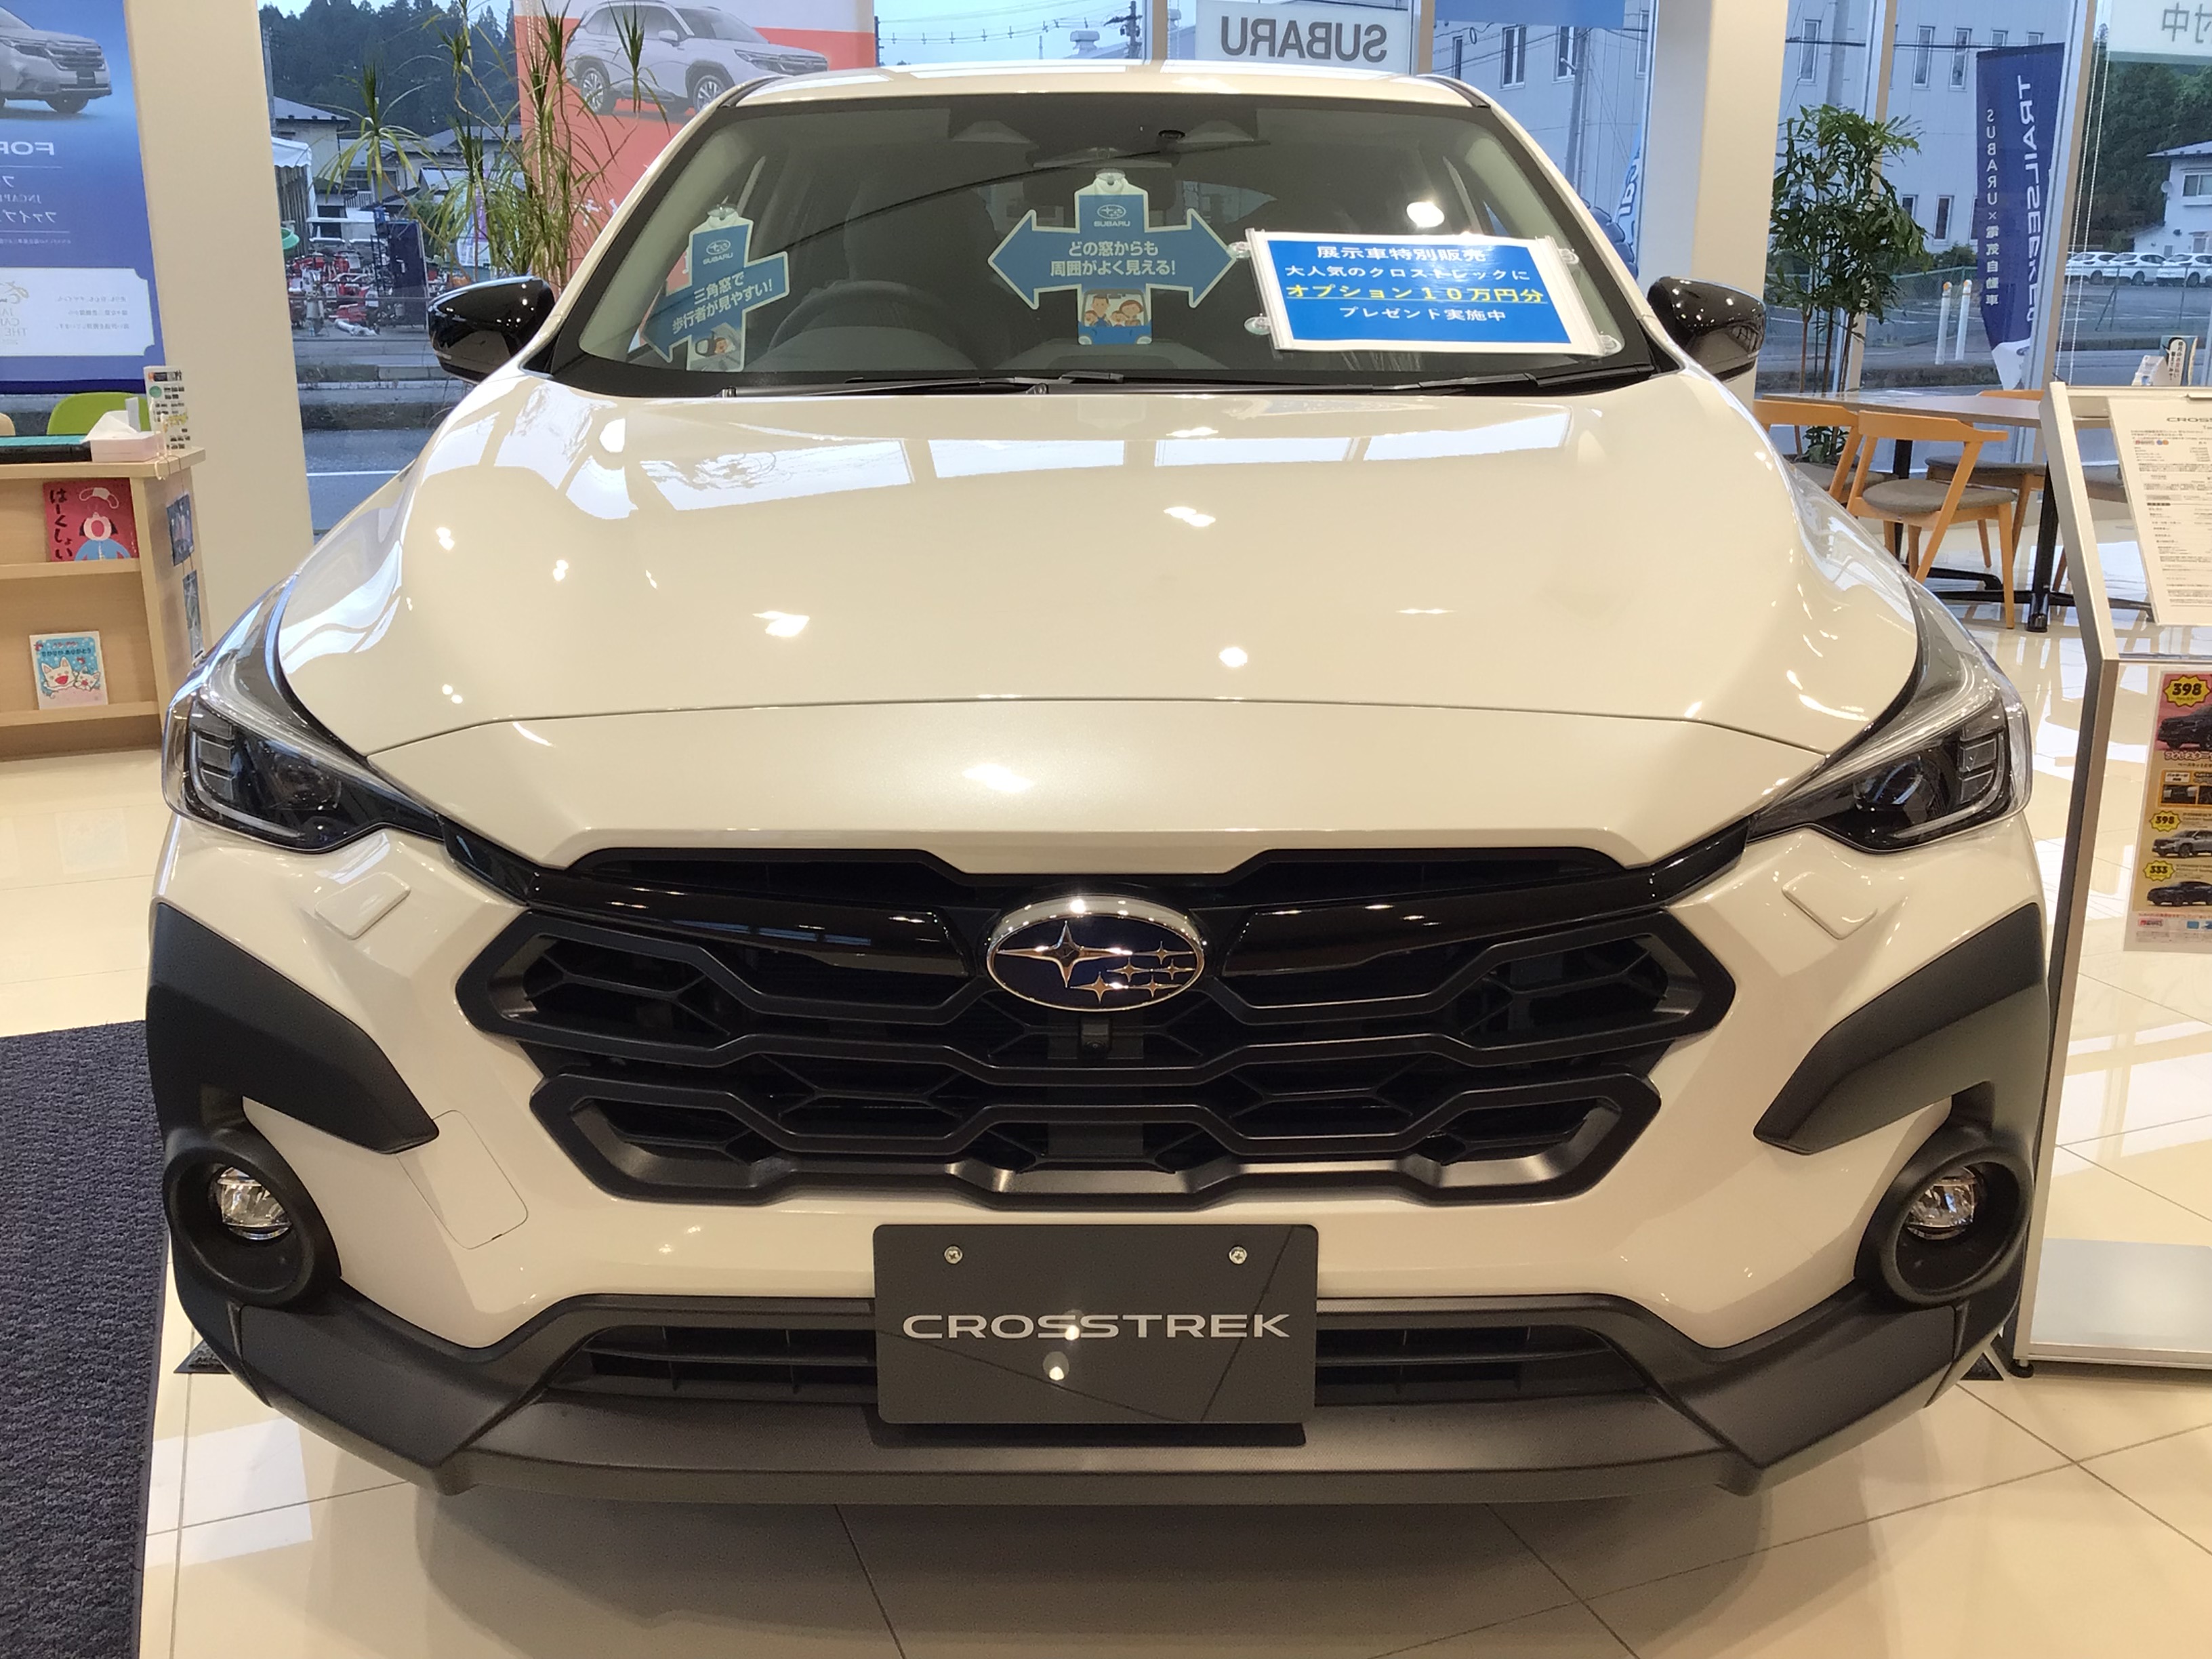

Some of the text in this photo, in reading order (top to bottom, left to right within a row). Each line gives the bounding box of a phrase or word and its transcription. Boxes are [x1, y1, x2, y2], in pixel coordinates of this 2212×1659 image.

[1068, 241, 1159, 257] どの窓からも
[1317, 245, 1486, 262] 展示車特別販売
[703, 252, 733, 265] SUBARU
[1050, 260, 1176, 277] 周囲がよく見える!
[1285, 265, 1530, 281] 大人気のクロストレックに
[1339, 306, 1506, 321] プレゼント実施中
[2172, 682, 2202, 696] 398
[2155, 816, 2175, 824] 398
[903, 1313, 1290, 1338] CROSSTREK
